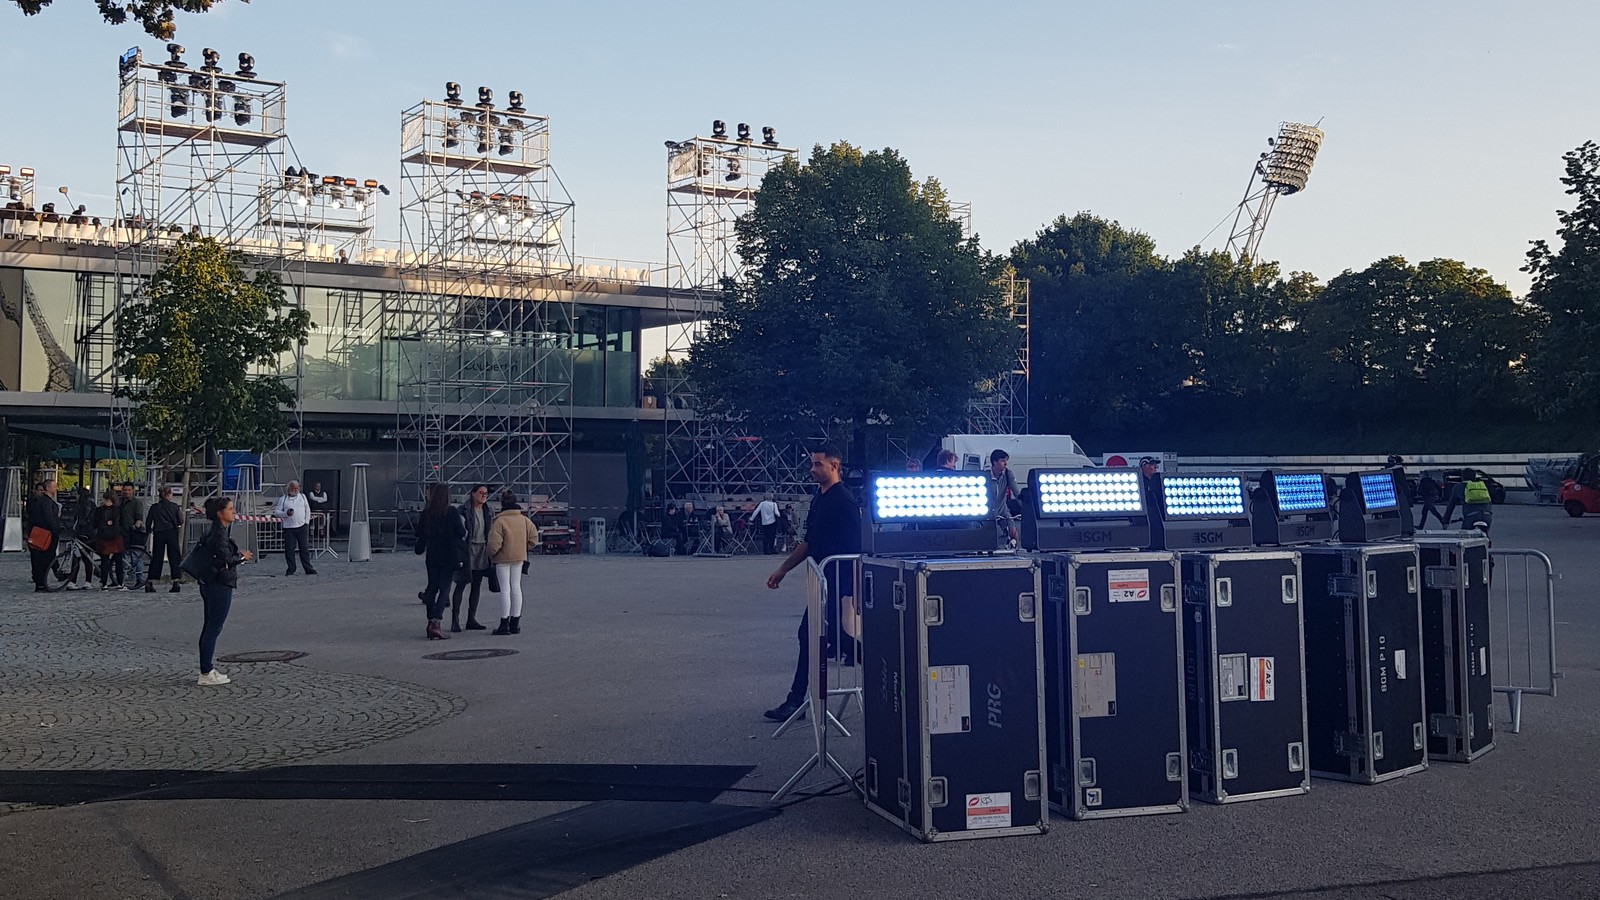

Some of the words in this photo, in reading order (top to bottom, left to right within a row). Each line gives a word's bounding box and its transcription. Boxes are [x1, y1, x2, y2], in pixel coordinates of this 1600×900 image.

[464, 360, 518, 372] Coubertn
[1082, 531, 1112, 543] SGM
[1200, 531, 1224, 543] SGM
[1124, 590, 1135, 598] A2
[1266, 672, 1272, 685] A2
[986, 682, 1003, 728] PRG
